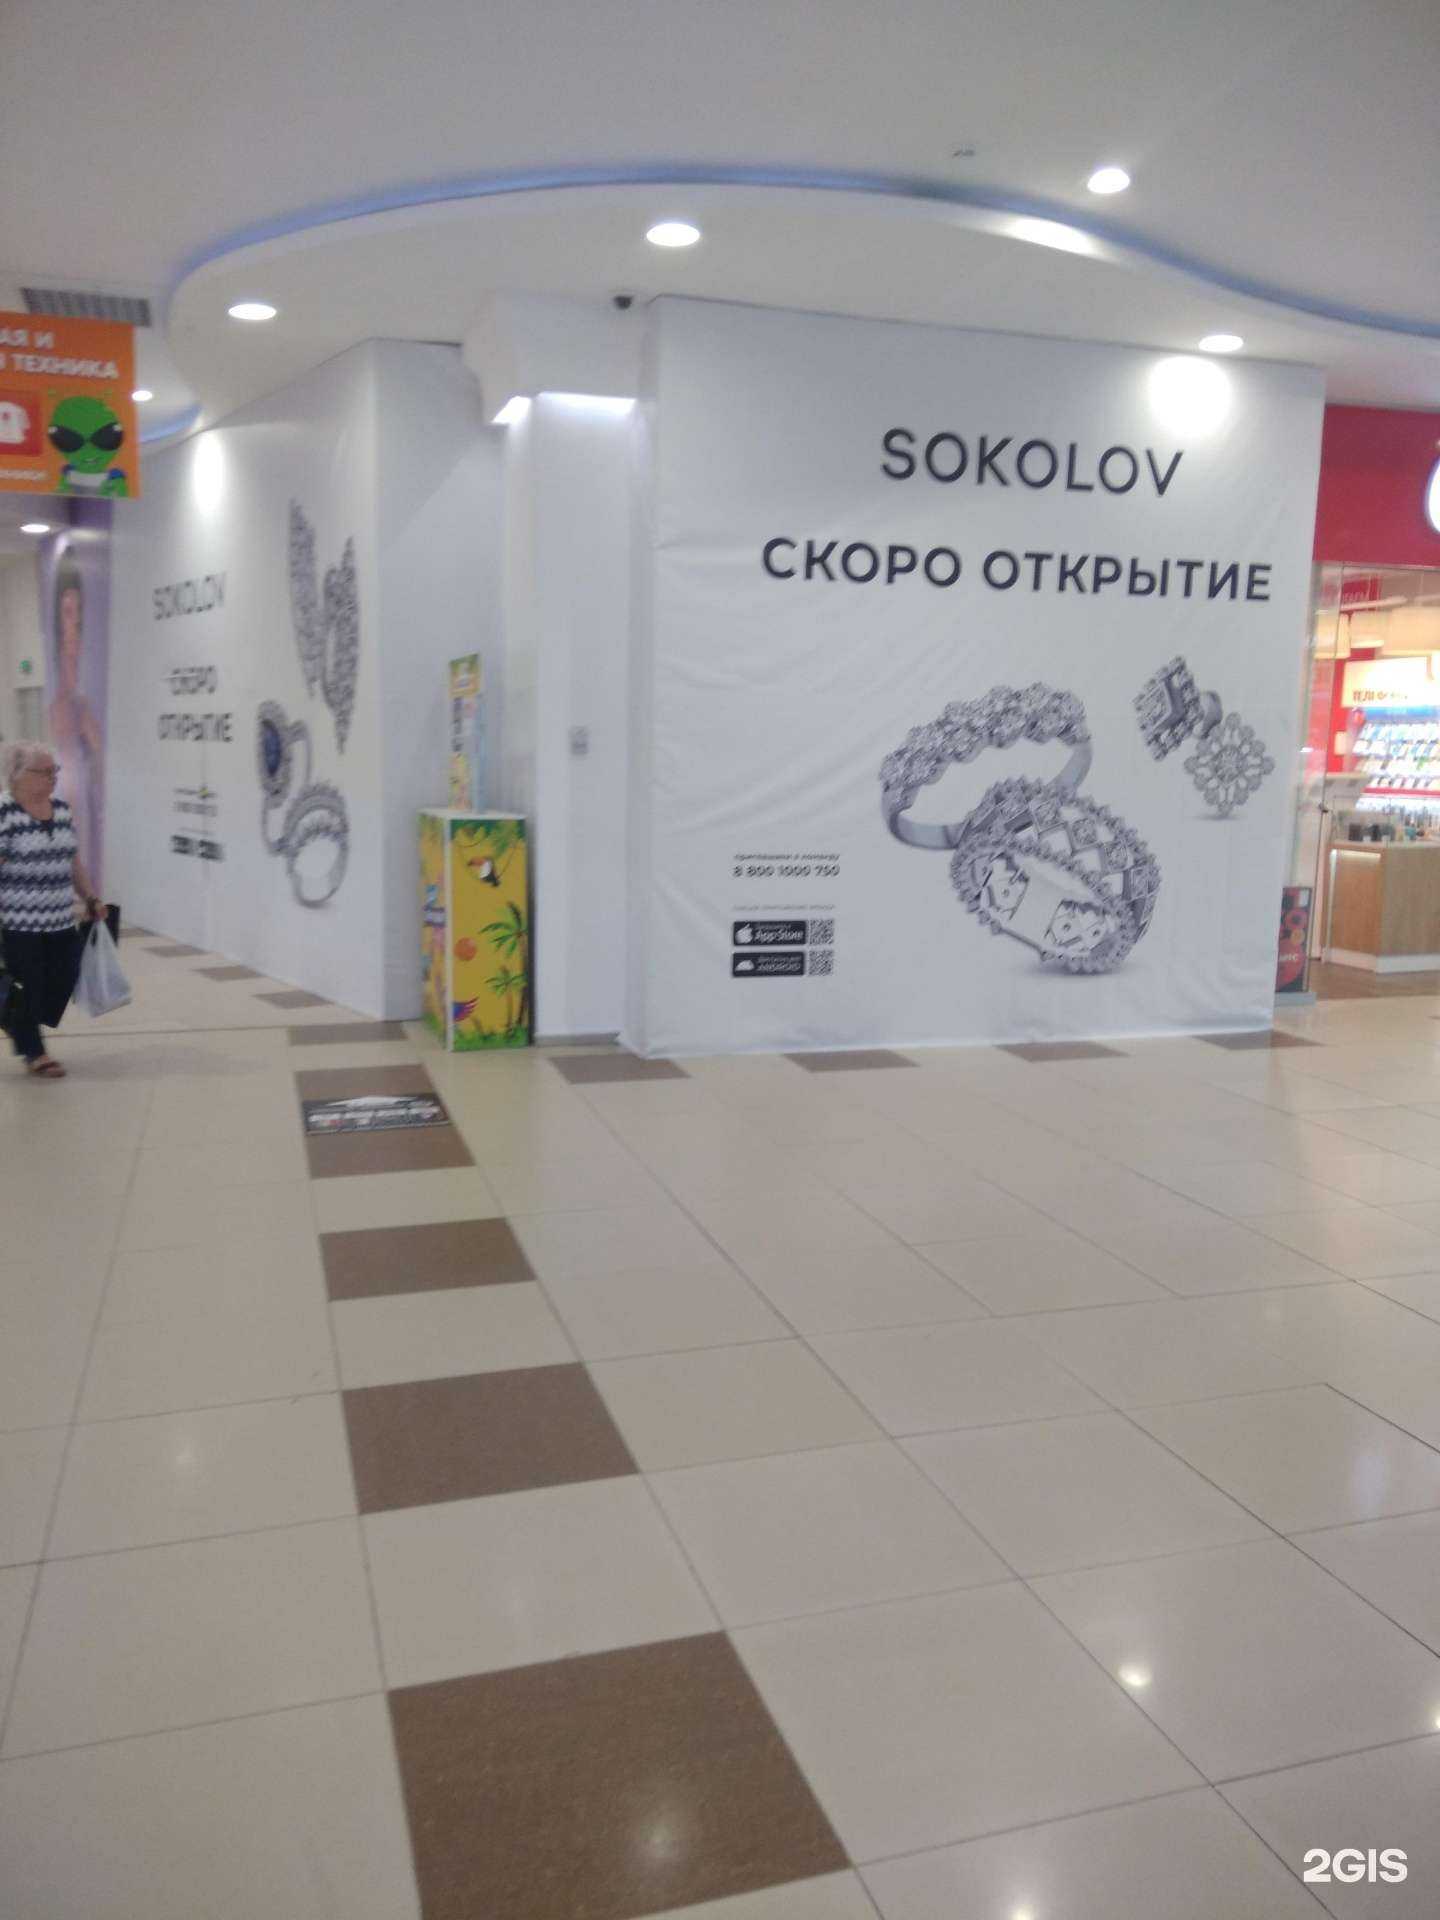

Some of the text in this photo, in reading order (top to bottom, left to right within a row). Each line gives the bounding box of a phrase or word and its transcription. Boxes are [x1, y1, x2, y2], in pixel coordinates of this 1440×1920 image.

[12, 354, 119, 379] ТЕХНИКА
[880, 427, 1184, 496] SOKOLOV
[762, 537, 1273, 601] СКОРО ОТКРЫТИЕ
